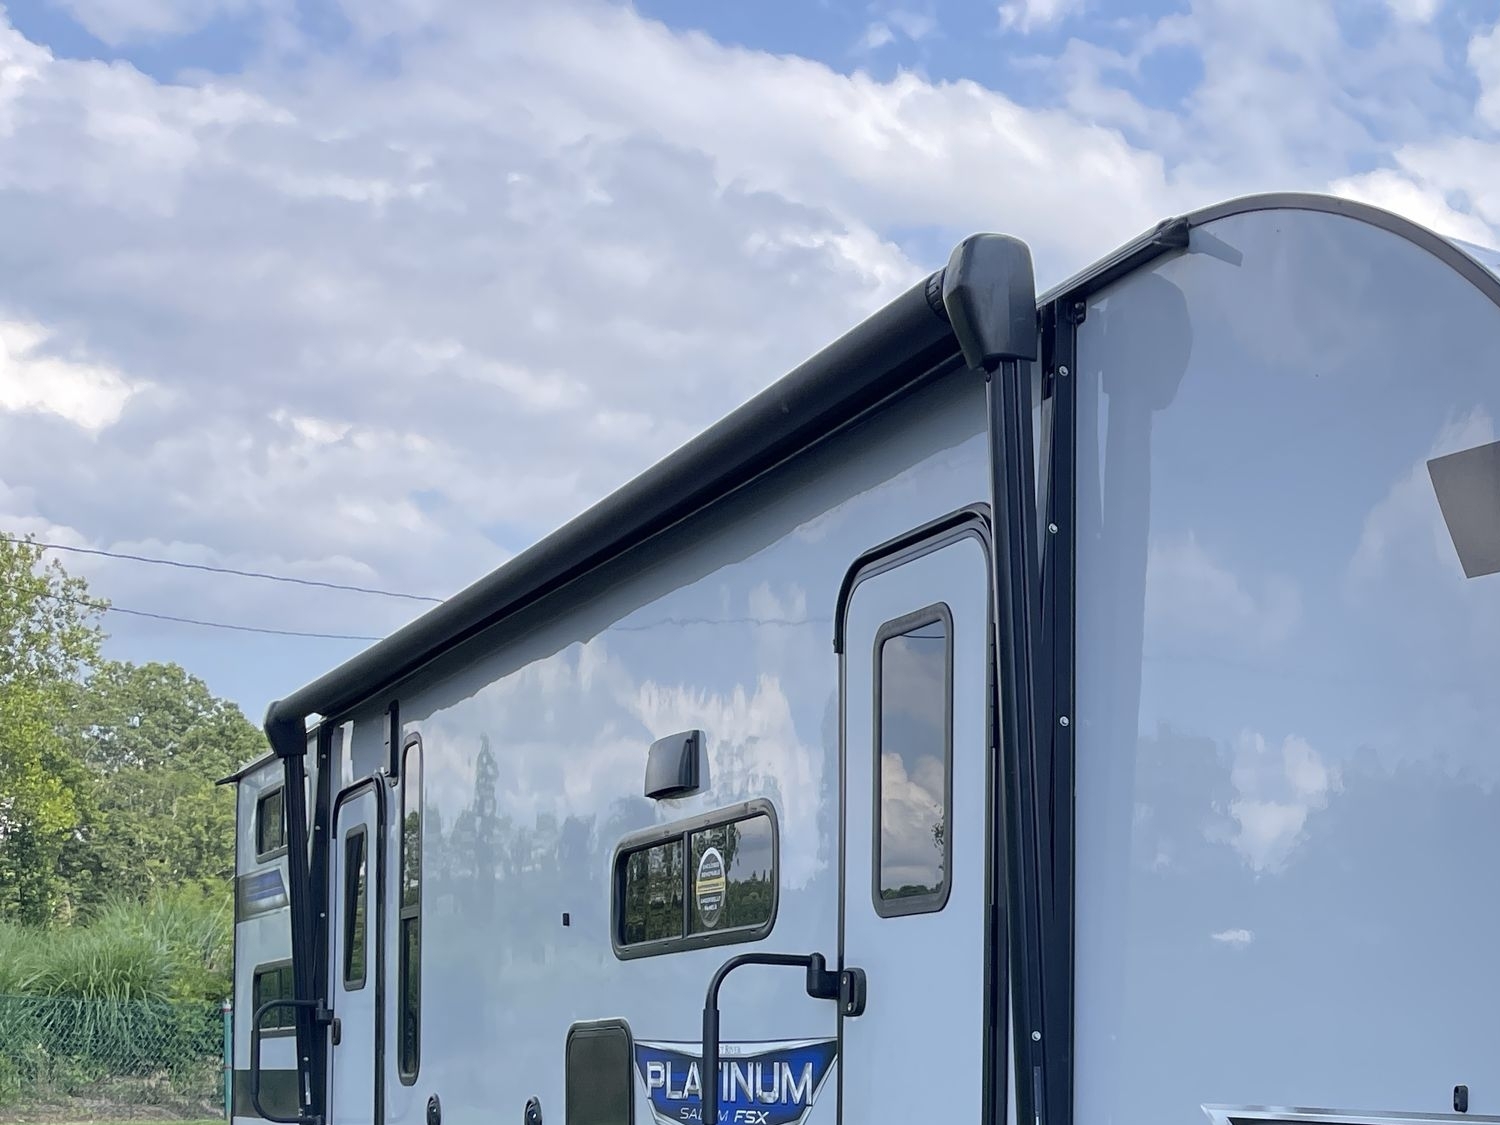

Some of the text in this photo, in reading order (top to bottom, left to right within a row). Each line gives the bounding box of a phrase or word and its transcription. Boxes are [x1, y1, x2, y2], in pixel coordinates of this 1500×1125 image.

[646, 1060, 814, 1106] PLAINUM
[679, 1107, 770, 1125] SALM FSX
